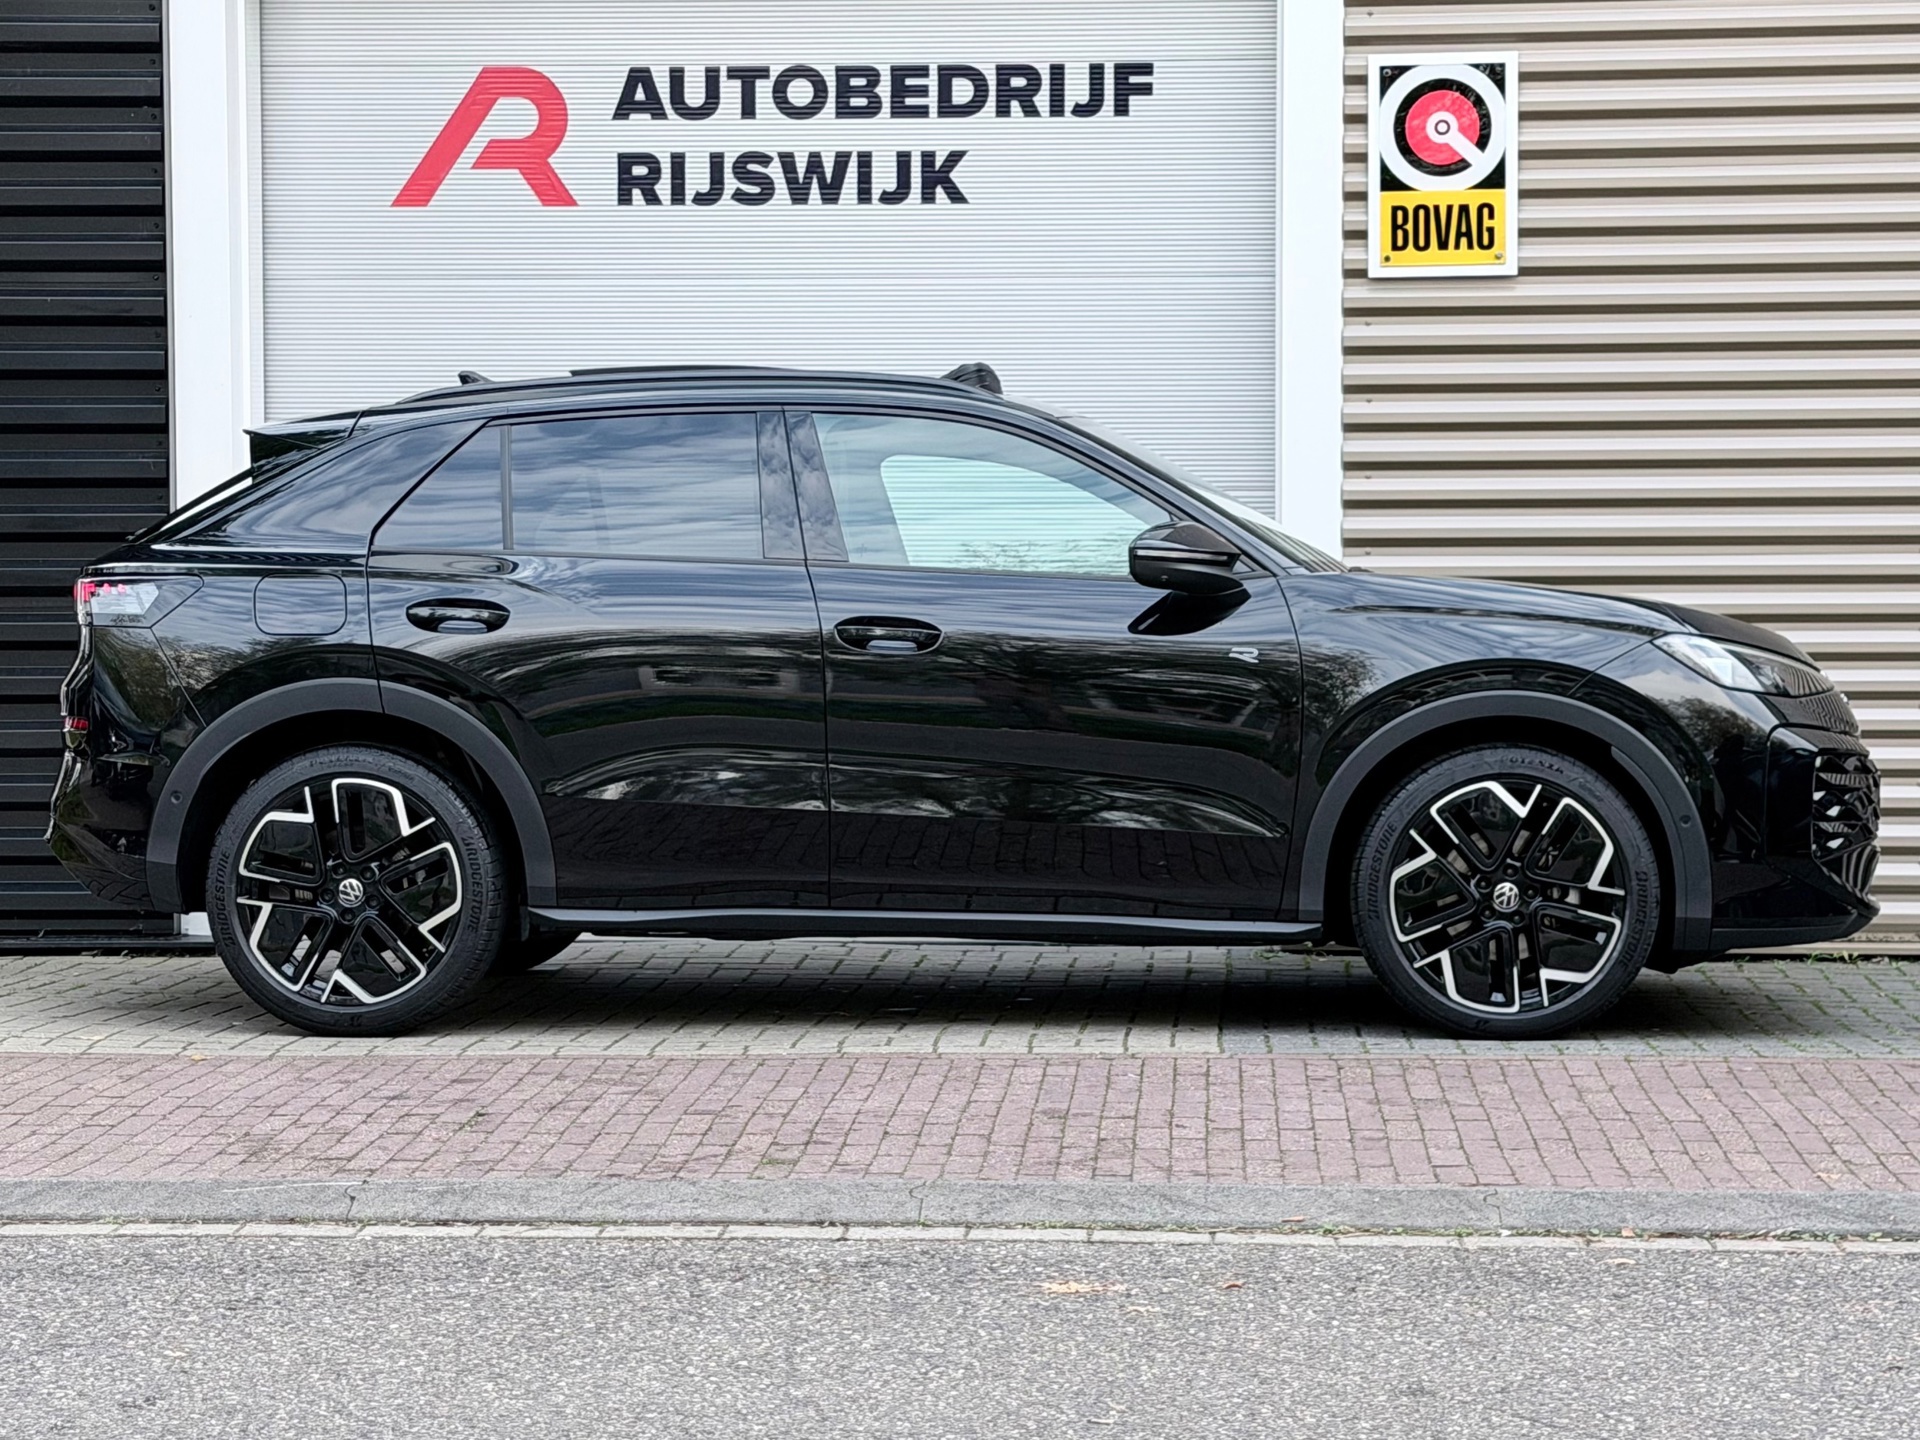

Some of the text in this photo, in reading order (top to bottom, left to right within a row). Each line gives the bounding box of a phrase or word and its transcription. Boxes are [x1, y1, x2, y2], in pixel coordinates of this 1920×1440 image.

[612, 62, 1155, 121] AUTOBEDRIJF
[616, 149, 970, 207] RIJSWIJK
[1390, 202, 1496, 252] BOVAG
